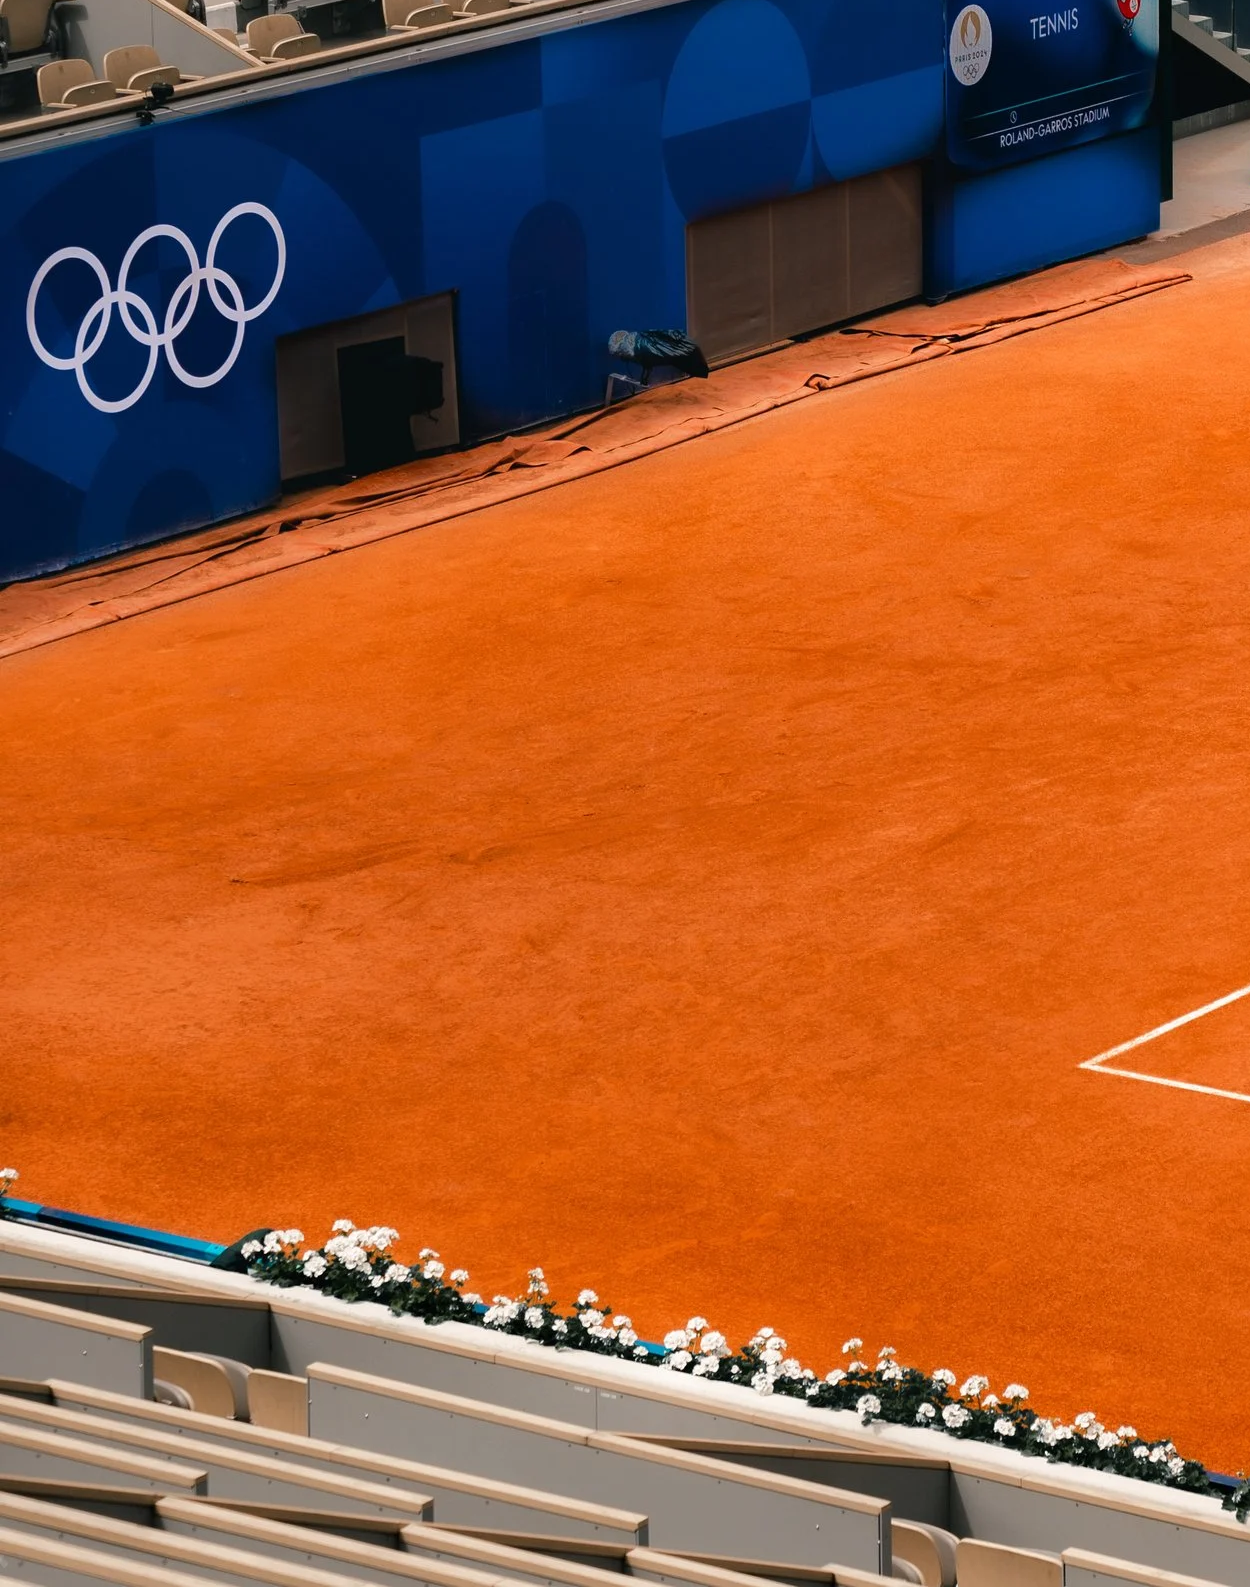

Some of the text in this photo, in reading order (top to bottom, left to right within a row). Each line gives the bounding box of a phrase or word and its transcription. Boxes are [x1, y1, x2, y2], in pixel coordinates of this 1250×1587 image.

[1030, 8, 1079, 40] TENNIS
[1000, 106, 1110, 148] ROLAND-GARROS STADIUM
